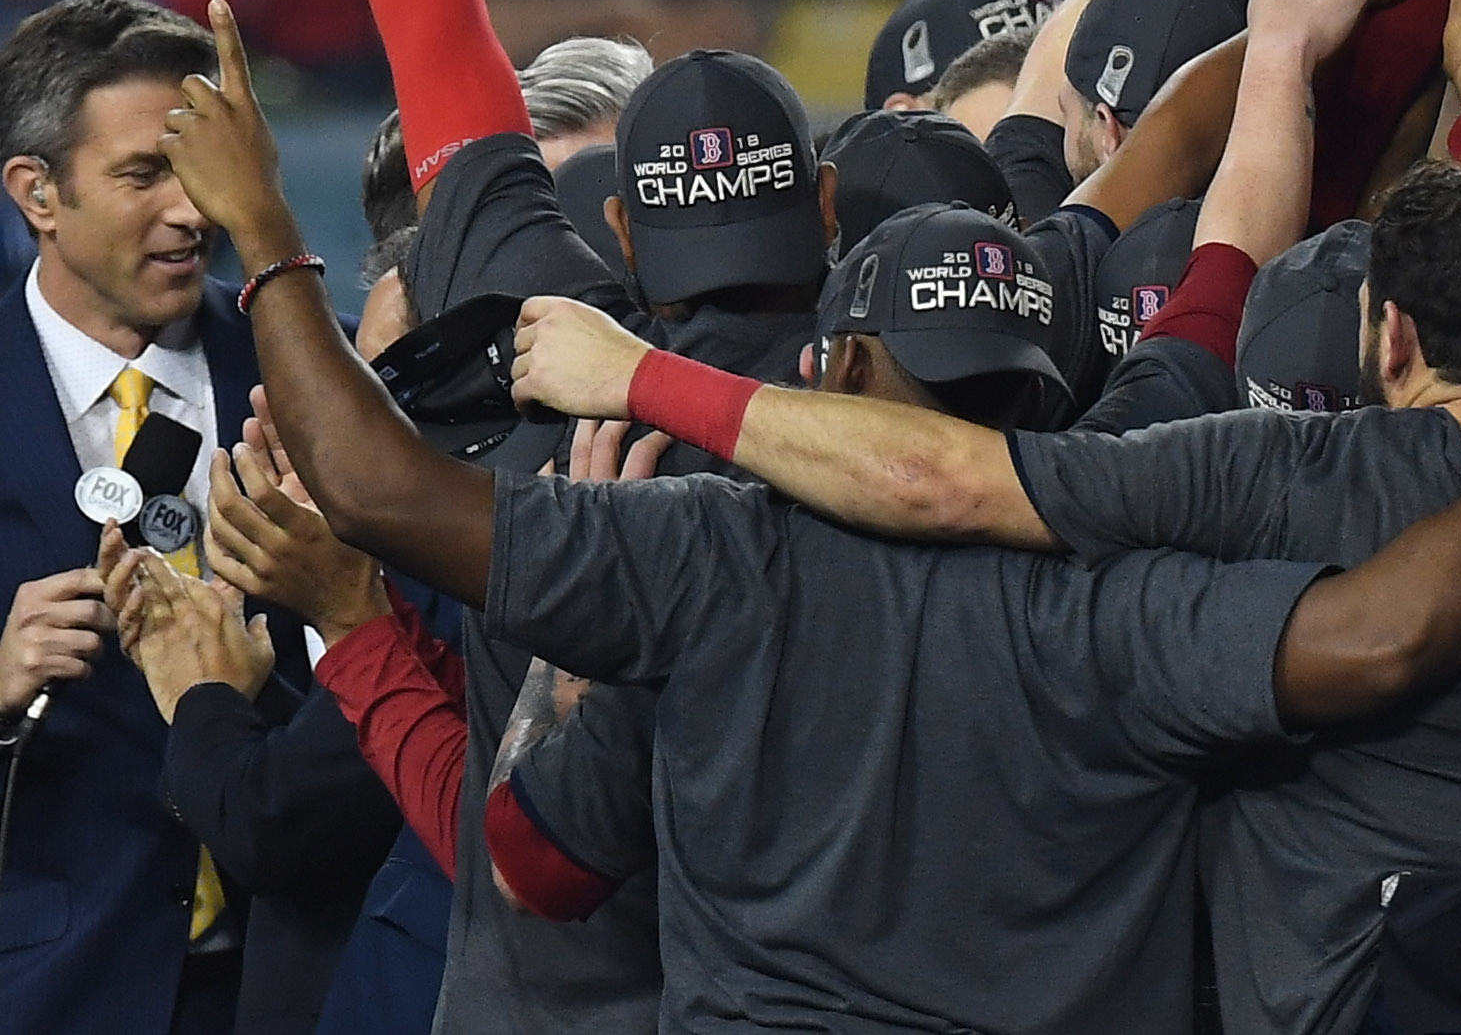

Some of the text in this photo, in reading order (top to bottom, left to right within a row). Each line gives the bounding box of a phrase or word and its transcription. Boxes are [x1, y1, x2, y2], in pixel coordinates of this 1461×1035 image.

[633, 143, 793, 176] WORLD SERIES
[660, 145, 685, 158] 20
[736, 134, 759, 149] 18
[637, 160, 795, 206] CHAMPS
[906, 266, 972, 281] WORLD
[942, 252, 970, 264] 20
[1016, 261, 1034, 274] 18
[911, 280, 1053, 326] CHAMPS
[1112, 296, 1129, 310] 20
[91, 476, 131, 507] FOX
[153, 502, 188, 535] FOX
